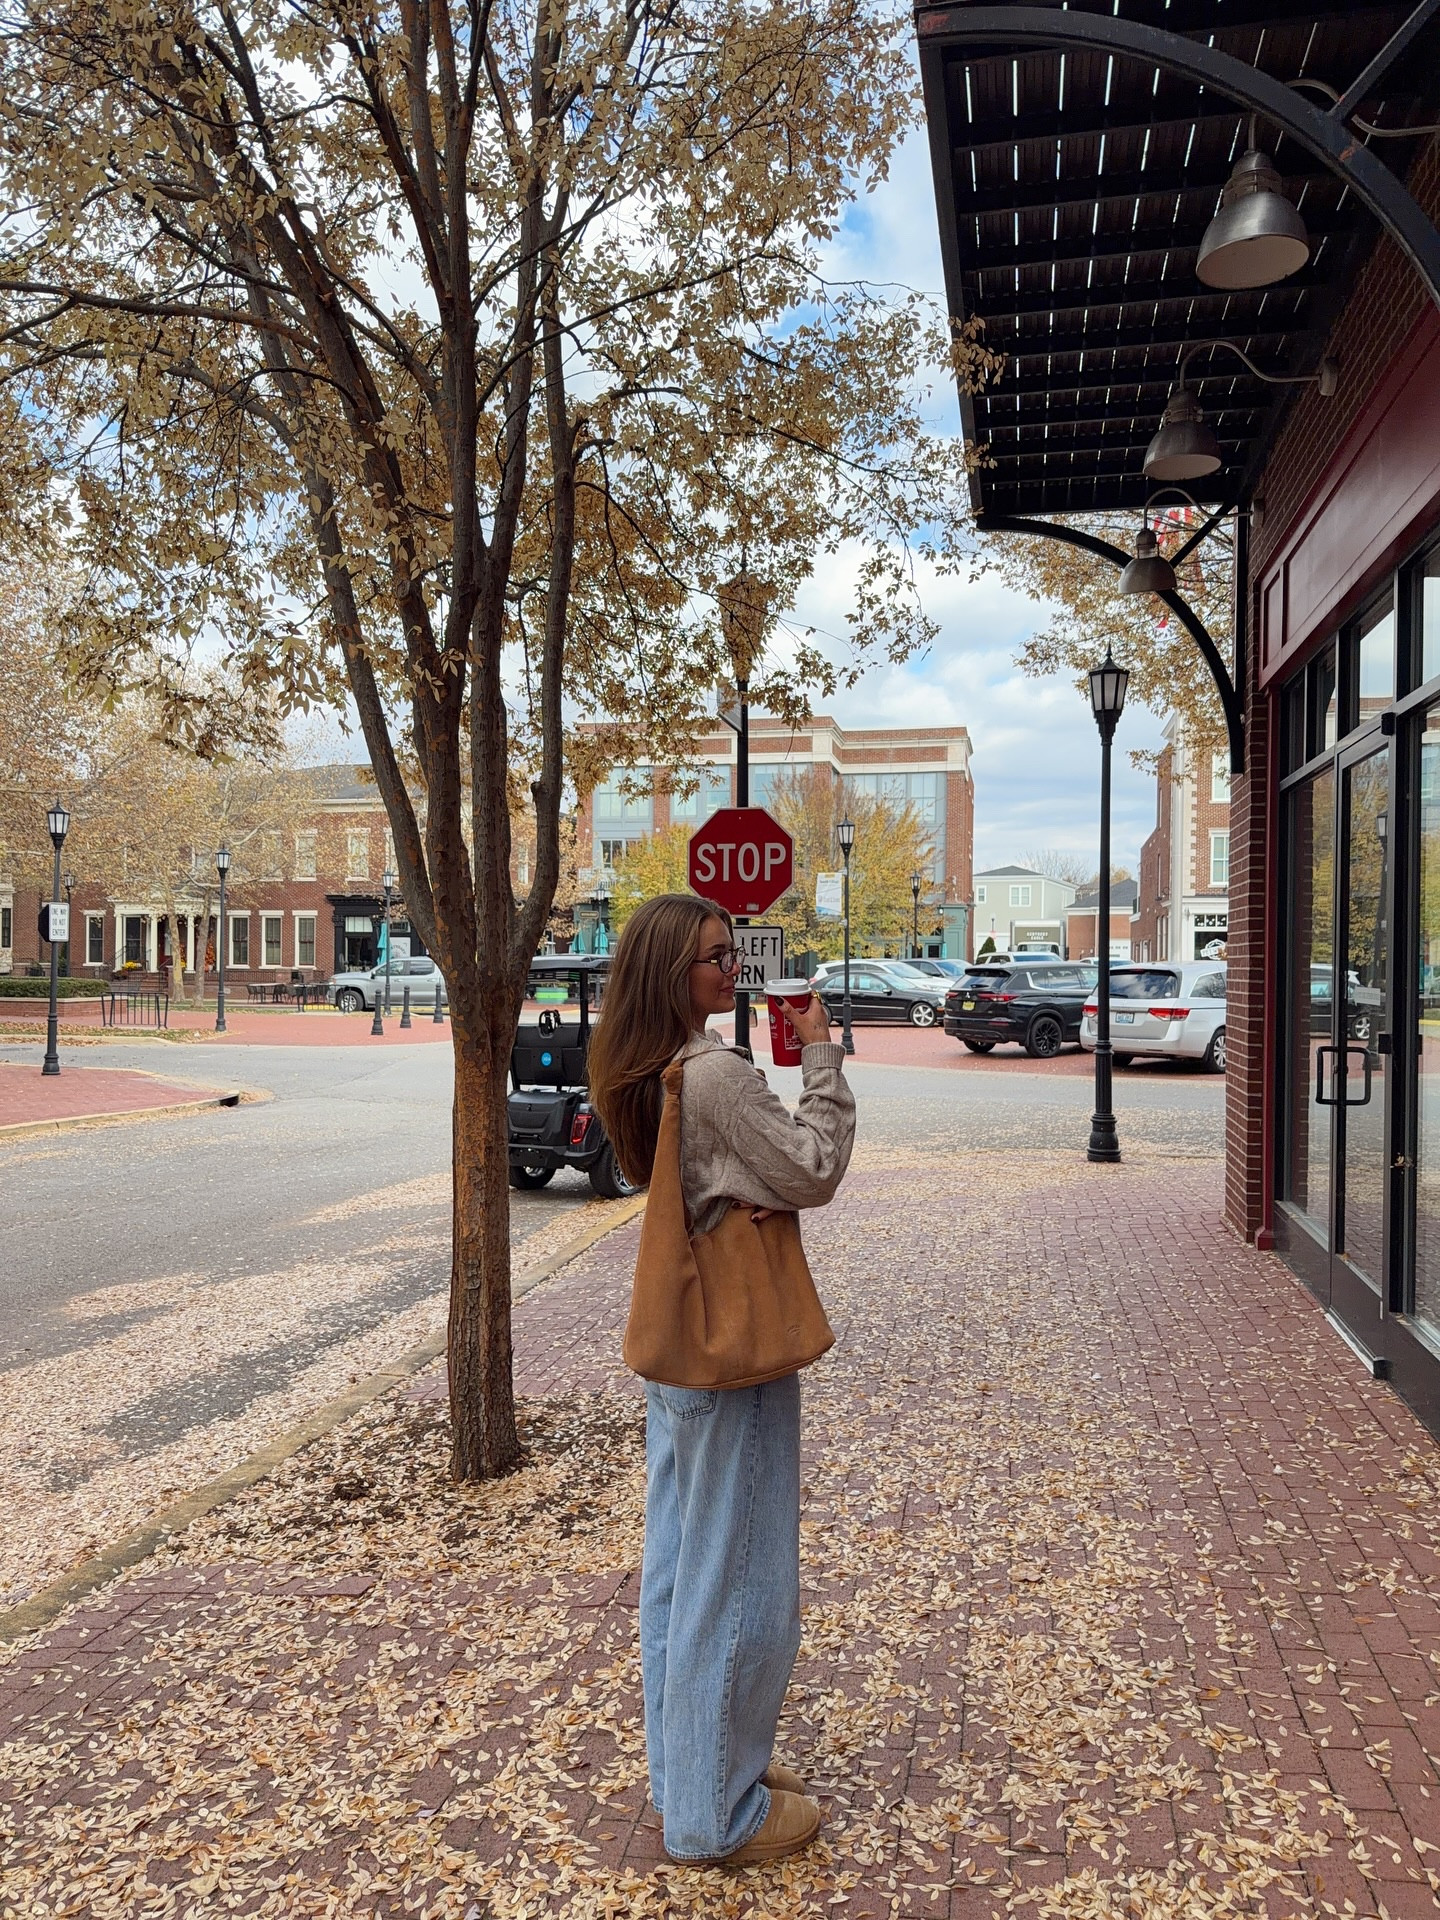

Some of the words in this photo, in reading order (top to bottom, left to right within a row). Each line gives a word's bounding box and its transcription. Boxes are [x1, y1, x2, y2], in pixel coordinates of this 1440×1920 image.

[695, 842, 787, 883] STOP
[52, 928, 66, 936] ENTER
[741, 936, 779, 957] LEFT
[735, 964, 765, 985] RN
